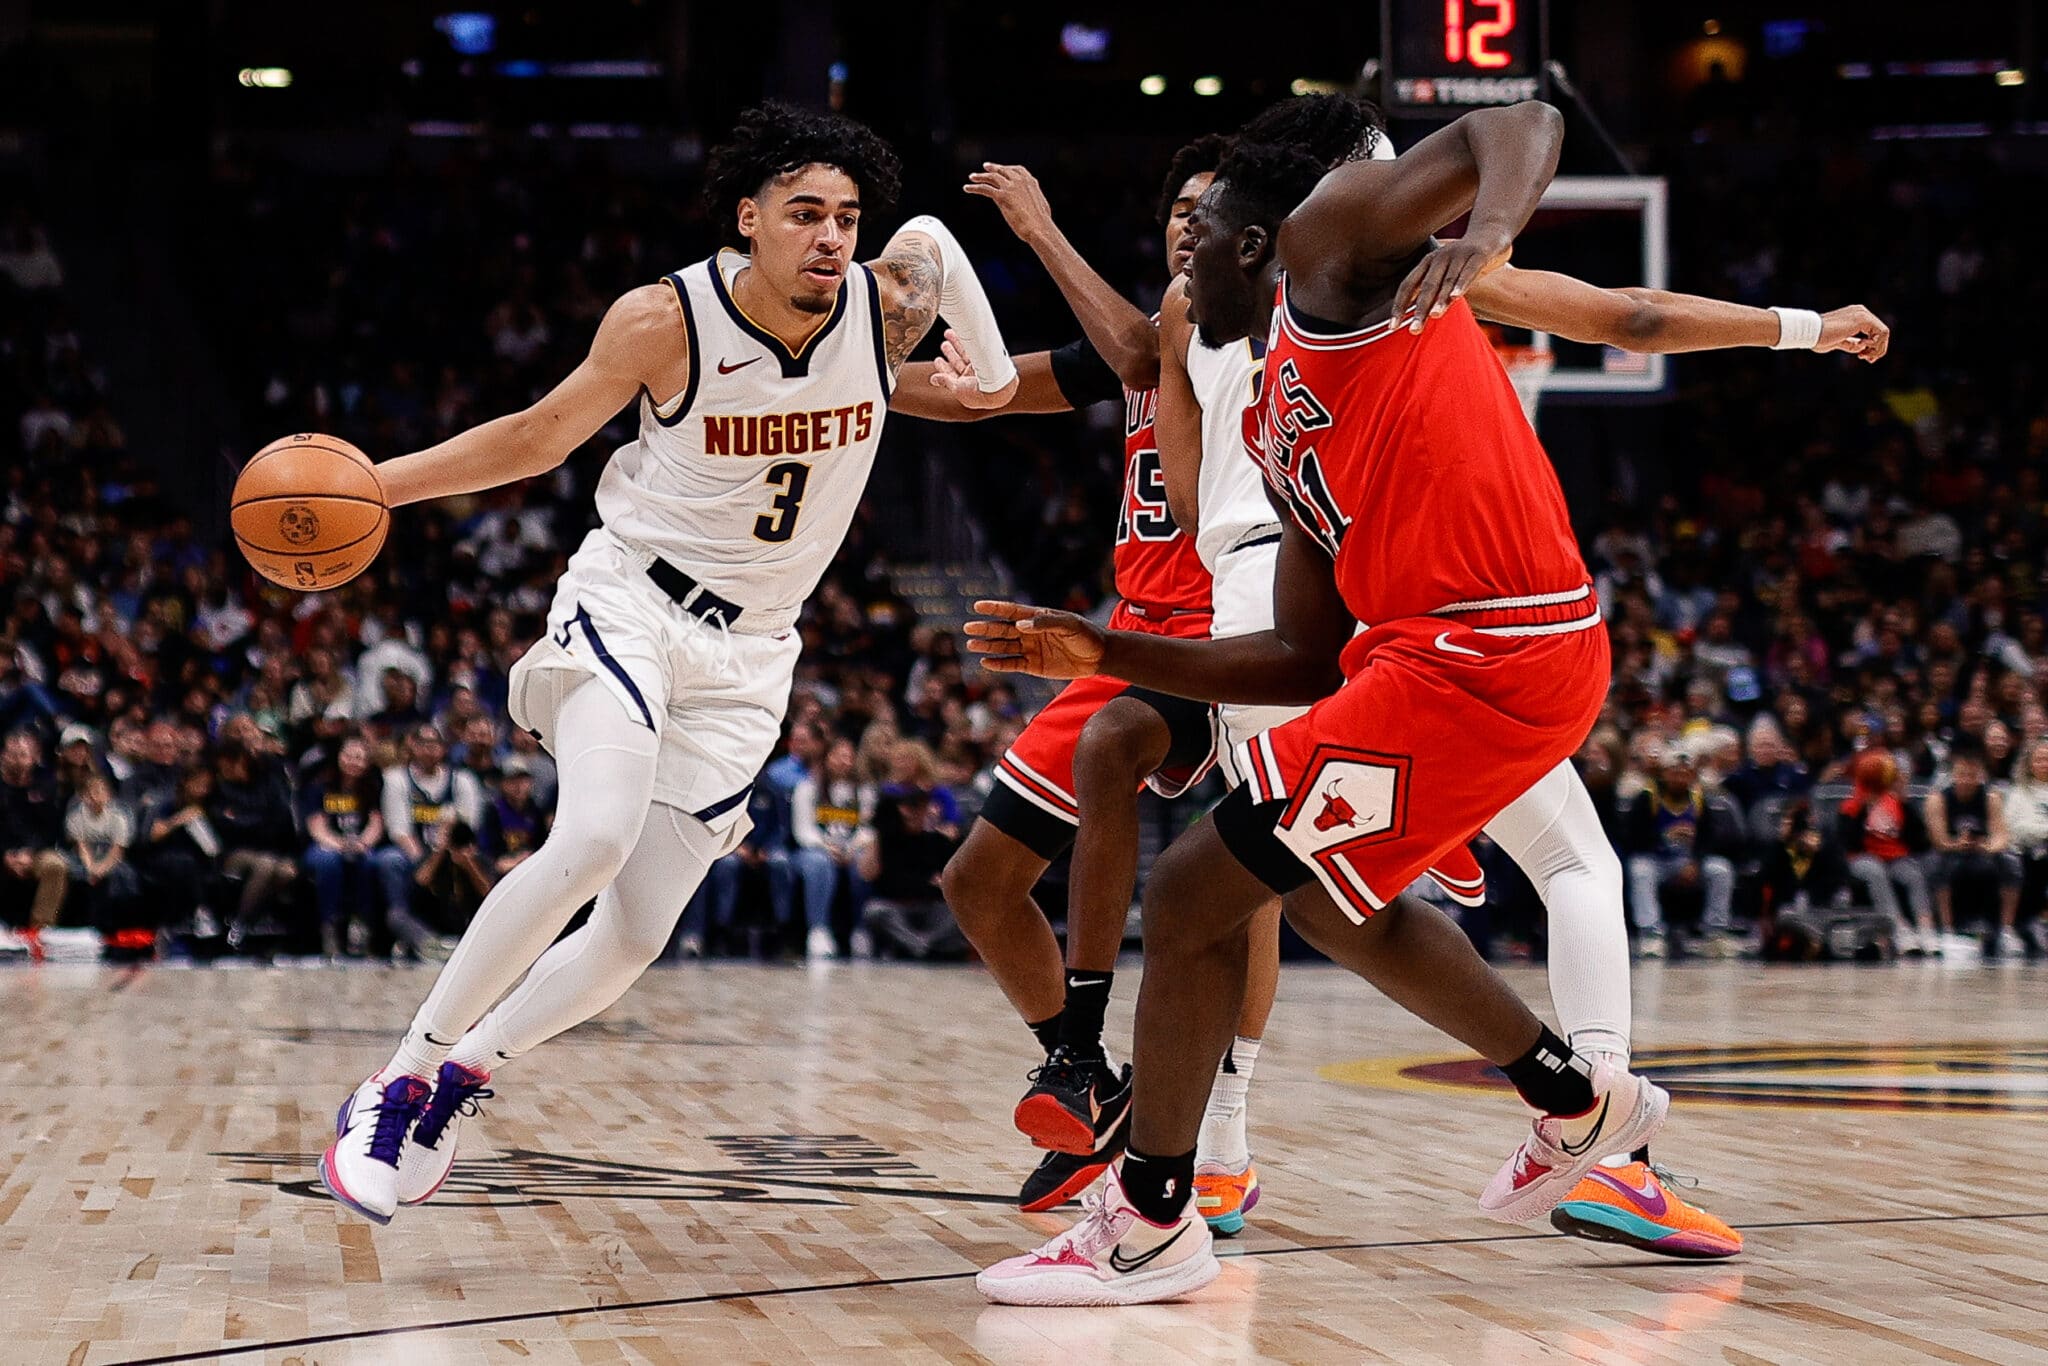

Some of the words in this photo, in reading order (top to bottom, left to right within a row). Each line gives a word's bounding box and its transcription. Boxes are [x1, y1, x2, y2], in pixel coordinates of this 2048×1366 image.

[1445, 0, 1516, 67] 12
[1435, 77, 1538, 104] TISSOT
[703, 401, 873, 456] NUGGETS
[752, 461, 813, 543] 3
[1115, 448, 1182, 546] 15
